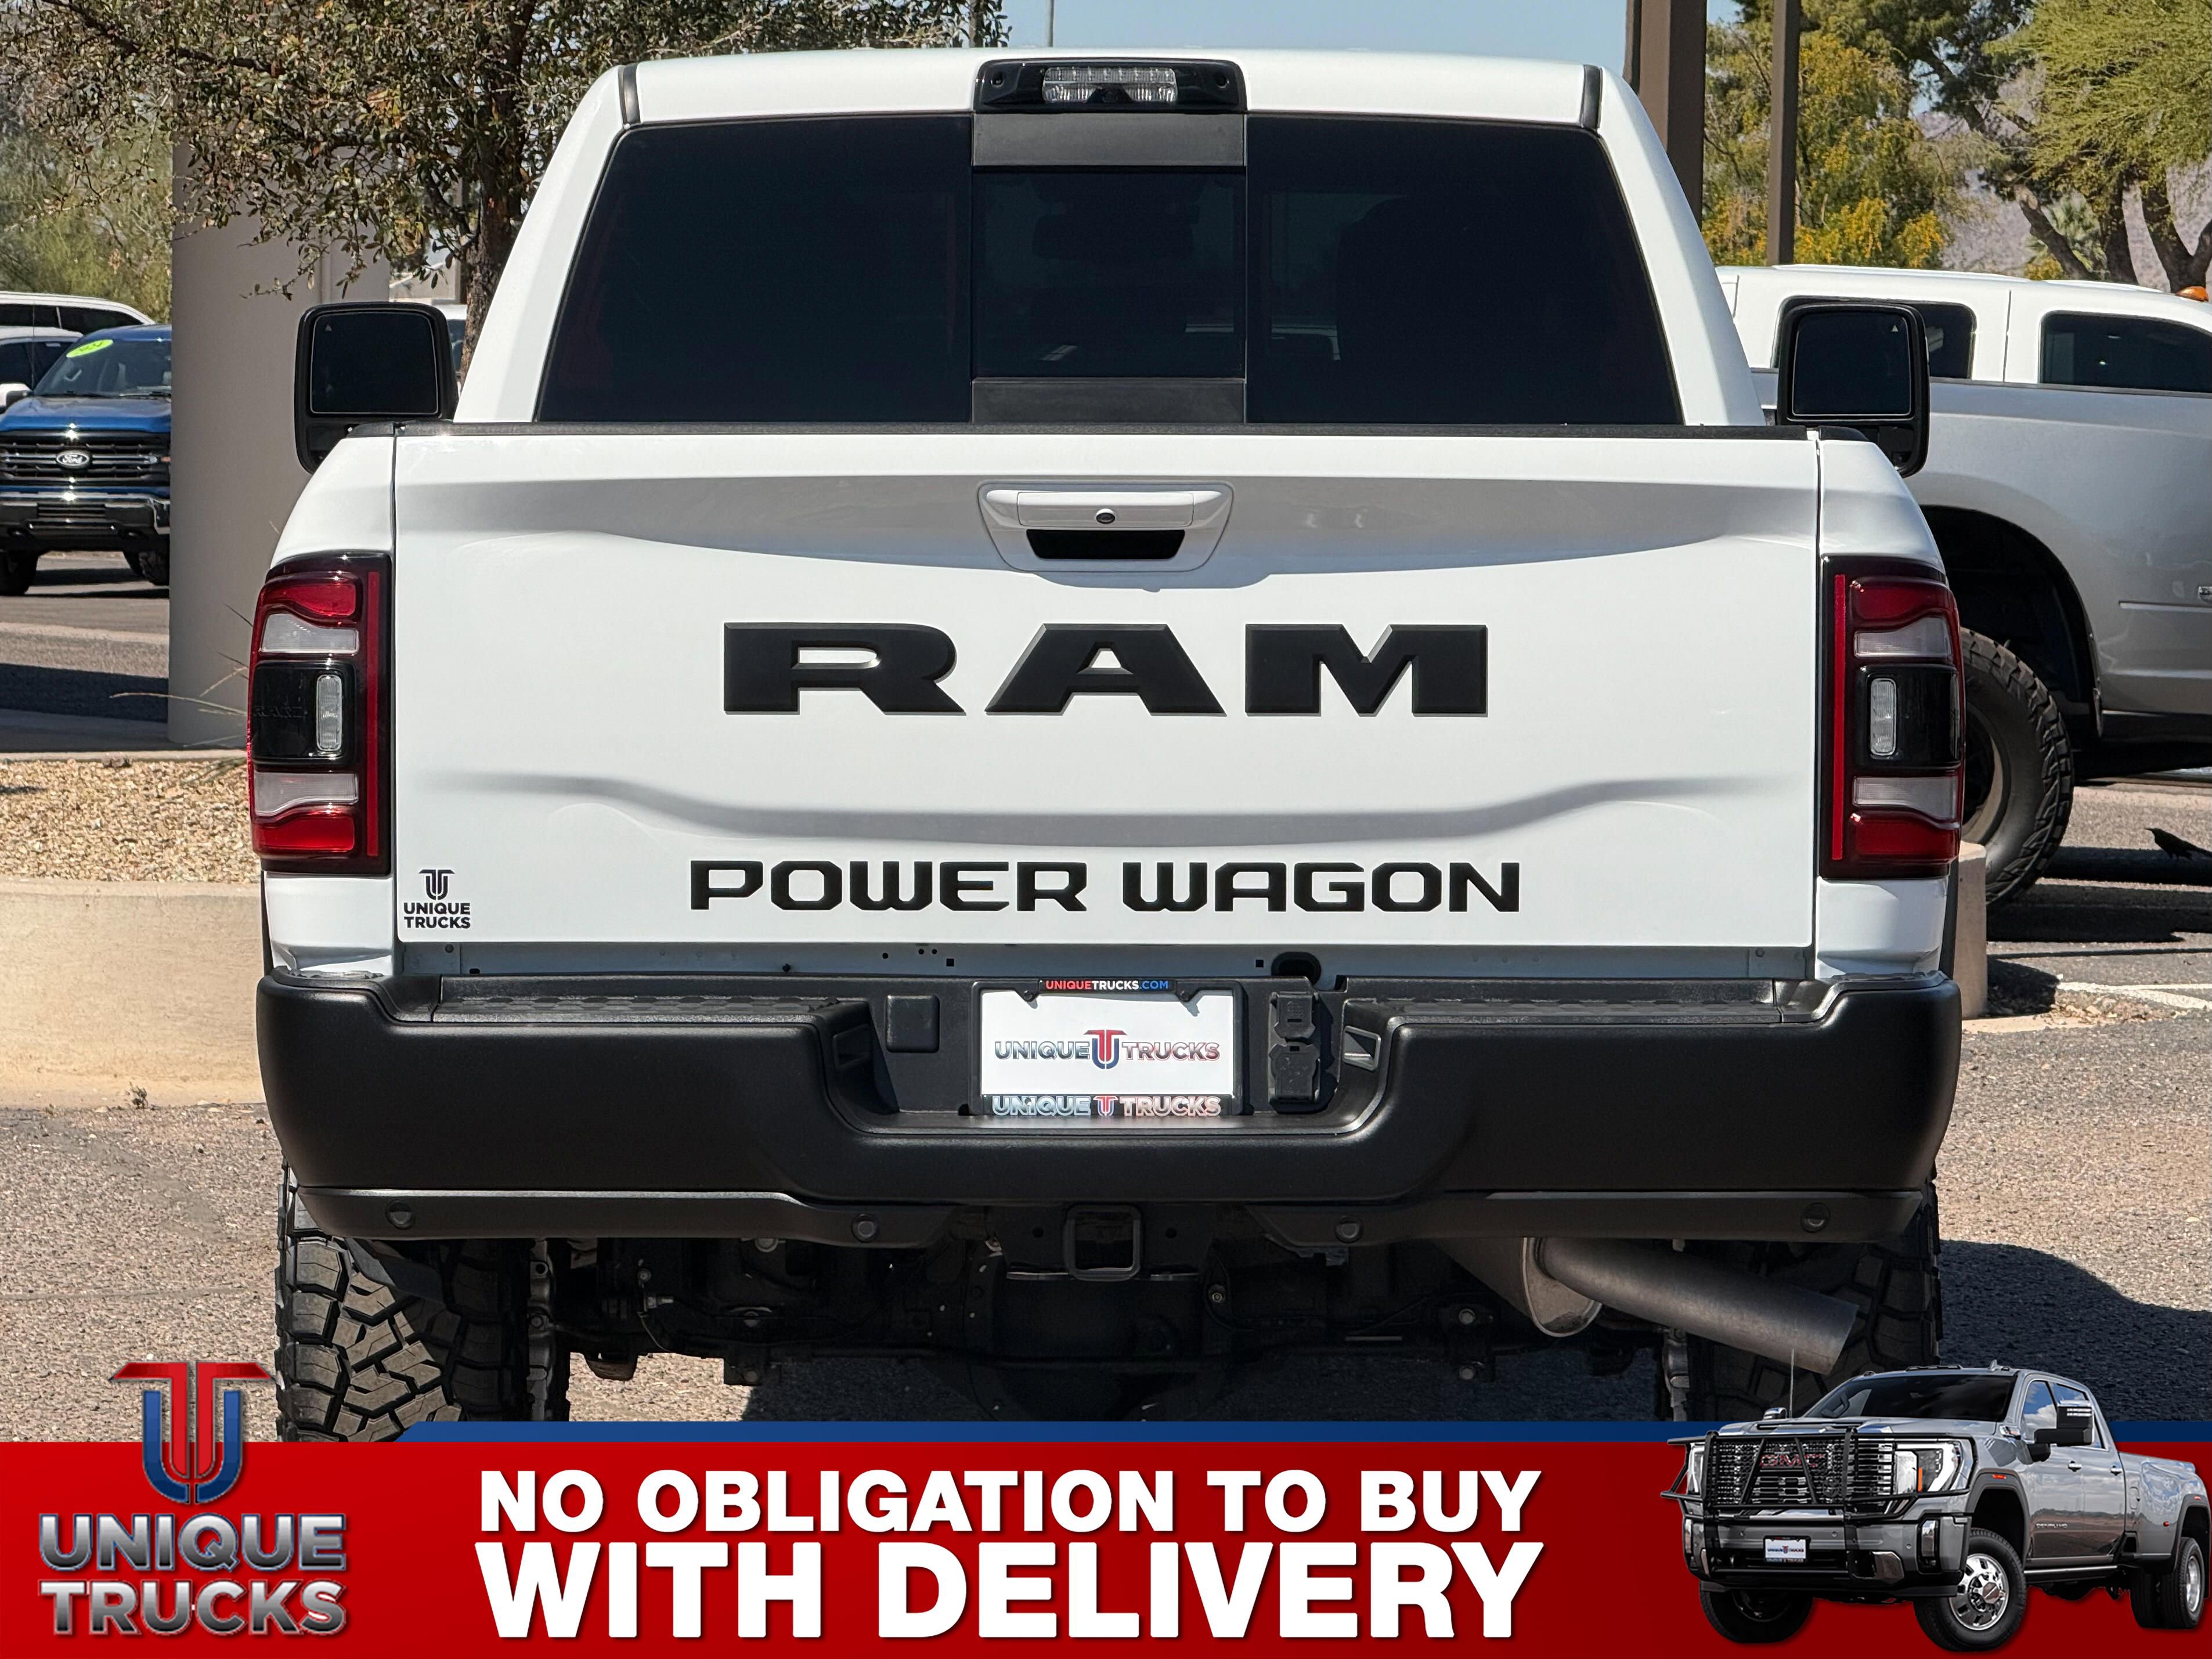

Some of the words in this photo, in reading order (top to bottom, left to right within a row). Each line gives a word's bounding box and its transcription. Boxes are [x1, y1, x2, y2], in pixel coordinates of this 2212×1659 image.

[723, 622, 1488, 716] RAM
[691, 860, 1087, 912] POWER
[1123, 862, 1520, 913] WAGON
[403, 902, 471, 915] UNIQUE
[403, 916, 471, 929] TRUCKS
[1045, 980, 1169, 990] UNIQUETRUCKS.COM
[994, 1041, 1090, 1060] UNIQUE
[1121, 1041, 1221, 1061] TRUCKS
[991, 1095, 1091, 1116] UNIQUE
[1119, 1095, 1221, 1117] TRUCKS
